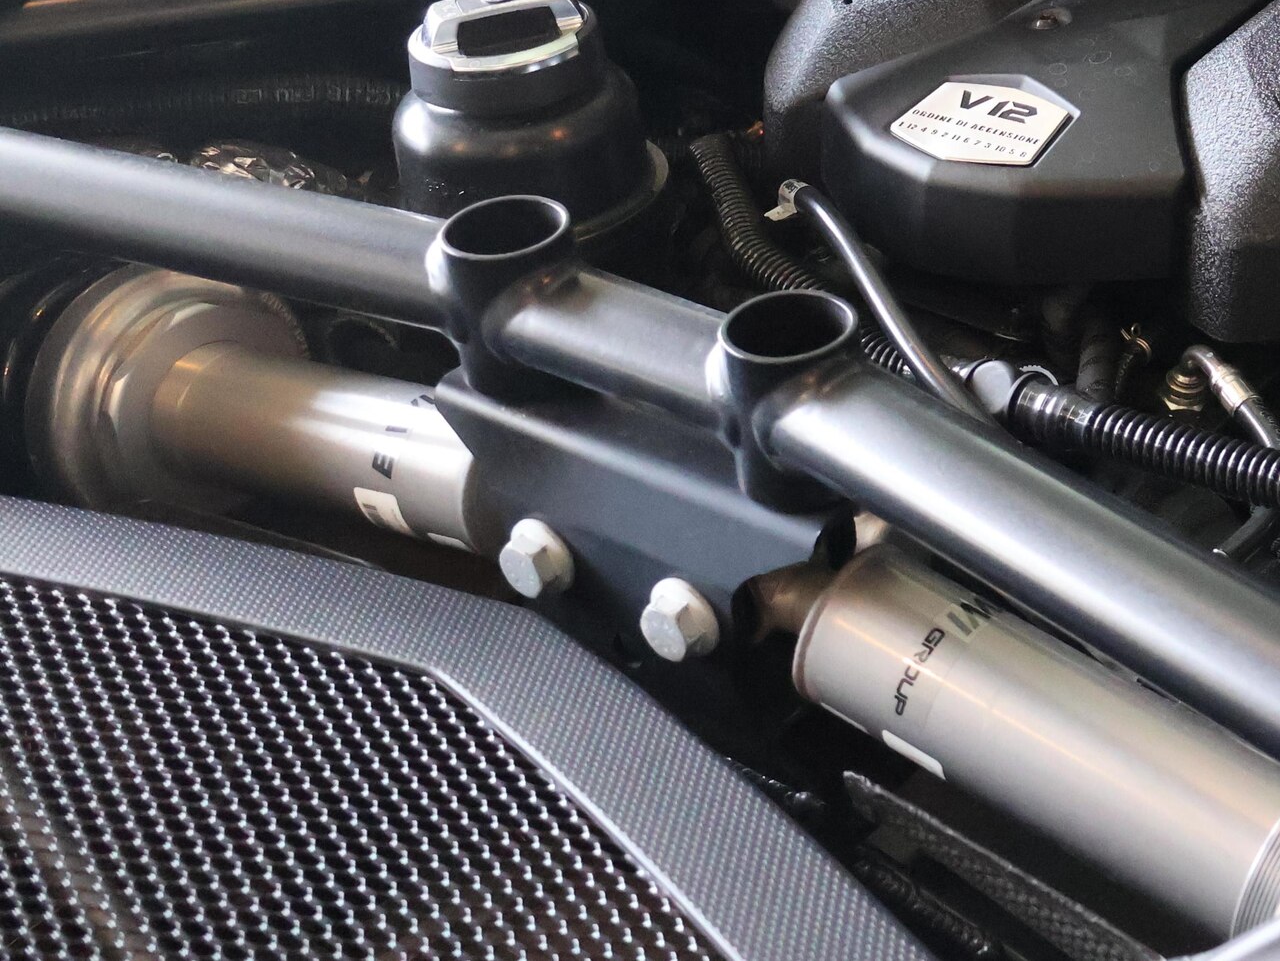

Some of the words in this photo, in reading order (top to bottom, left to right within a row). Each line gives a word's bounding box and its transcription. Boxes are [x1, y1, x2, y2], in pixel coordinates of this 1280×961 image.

[912, 108, 953, 124] ORDINE
[955, 119, 970, 128] DI
[959, 89, 1038, 124] V12
